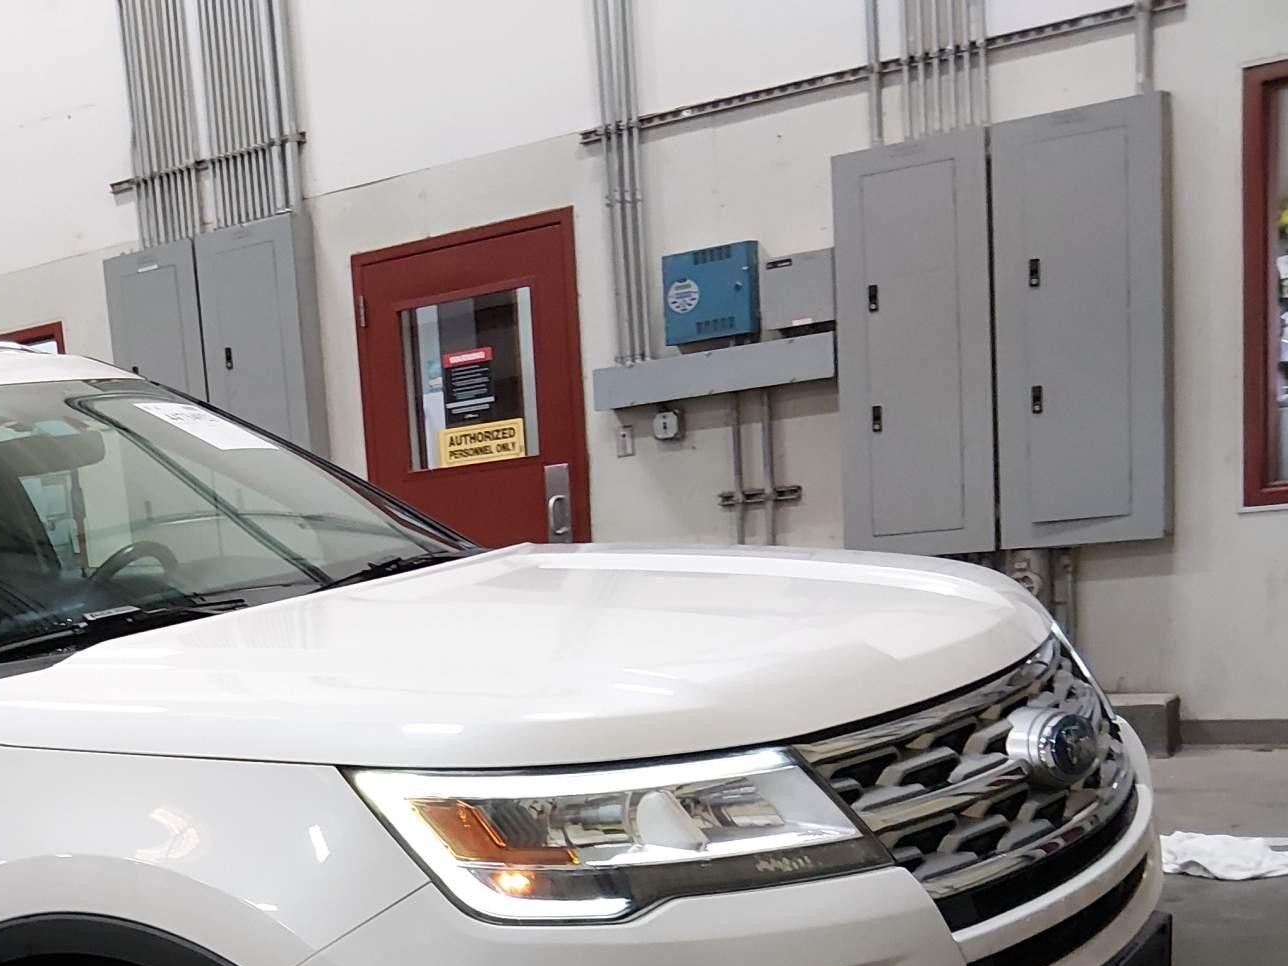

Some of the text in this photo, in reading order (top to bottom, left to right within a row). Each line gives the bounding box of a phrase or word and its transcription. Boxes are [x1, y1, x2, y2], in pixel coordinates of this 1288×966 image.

[448, 427, 516, 448] AUTHORIZED
[448, 441, 516, 459] PERSONNEL ONLY
